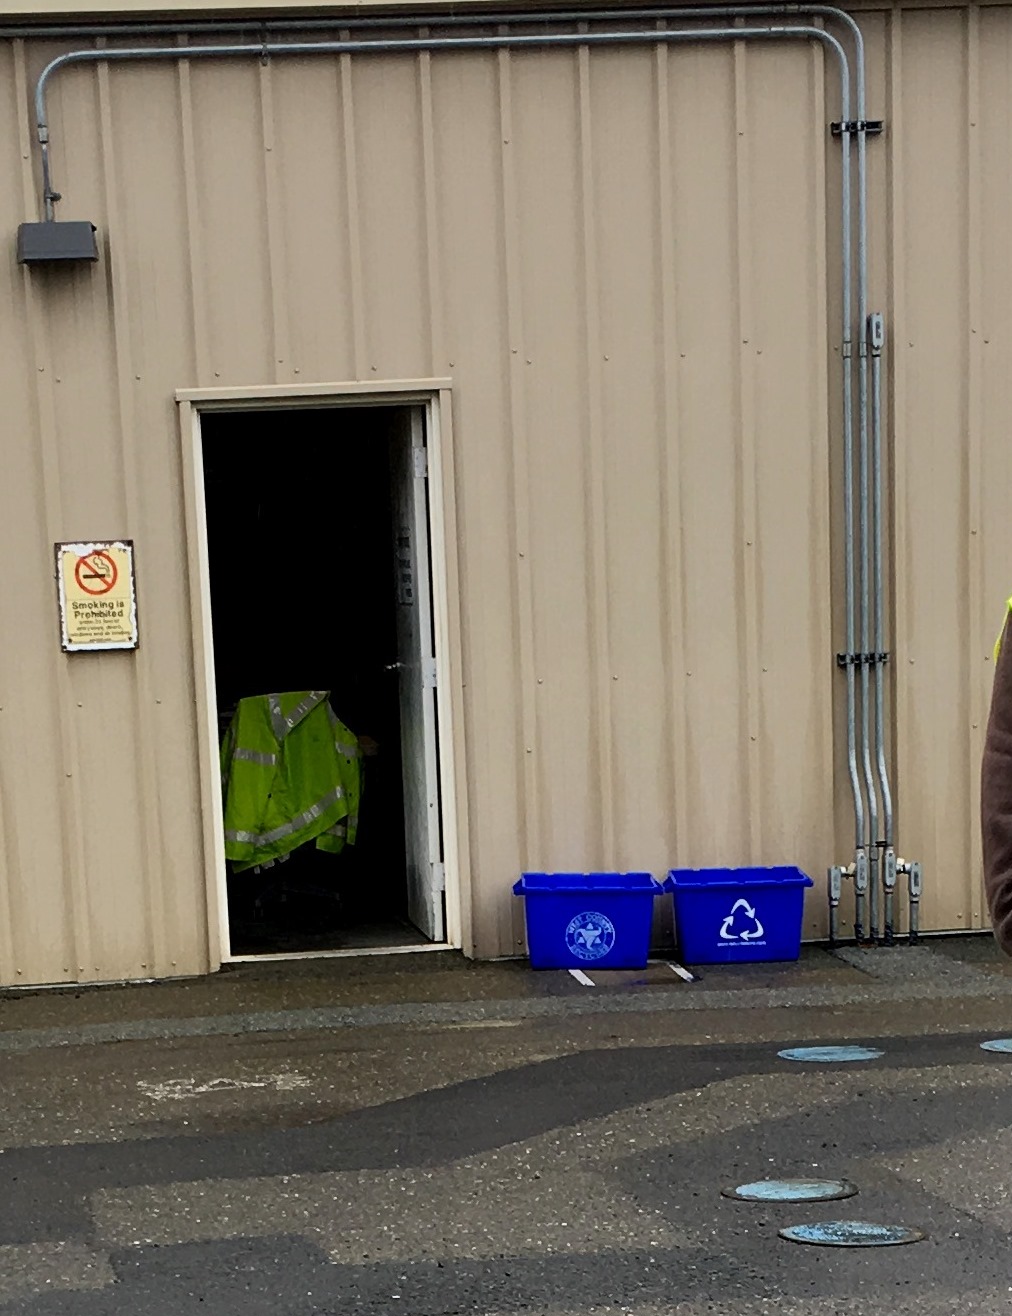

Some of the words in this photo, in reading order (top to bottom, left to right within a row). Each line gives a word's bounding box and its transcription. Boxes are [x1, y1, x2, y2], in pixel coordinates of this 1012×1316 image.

[72, 601, 114, 610] Smoking
[117, 600, 125, 608] is
[74, 610, 123, 619] Prohibited
